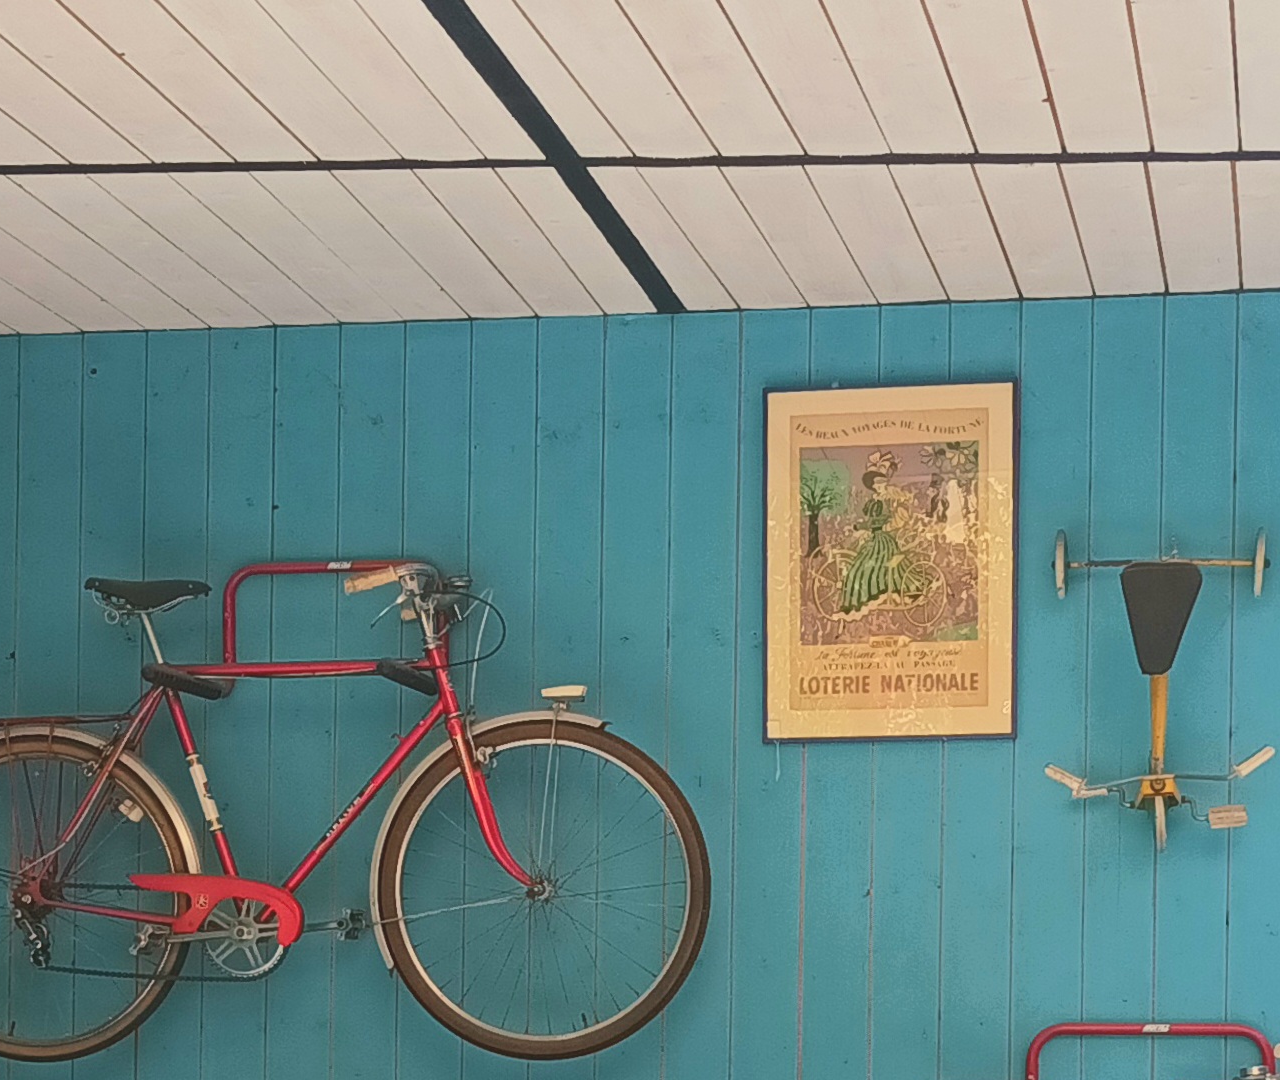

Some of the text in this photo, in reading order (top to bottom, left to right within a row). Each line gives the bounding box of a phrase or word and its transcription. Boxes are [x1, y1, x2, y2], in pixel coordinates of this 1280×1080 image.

[795, 423, 813, 437] LES
[815, 428, 849, 440] BEAUX
[852, 419, 896, 434] VOYAGES
[900, 420, 914, 430] DE
[918, 422, 930, 433] LA
[913, 659, 956, 669] PASSAGE
[799, 672, 979, 695] LOTERIE NATIONALE
